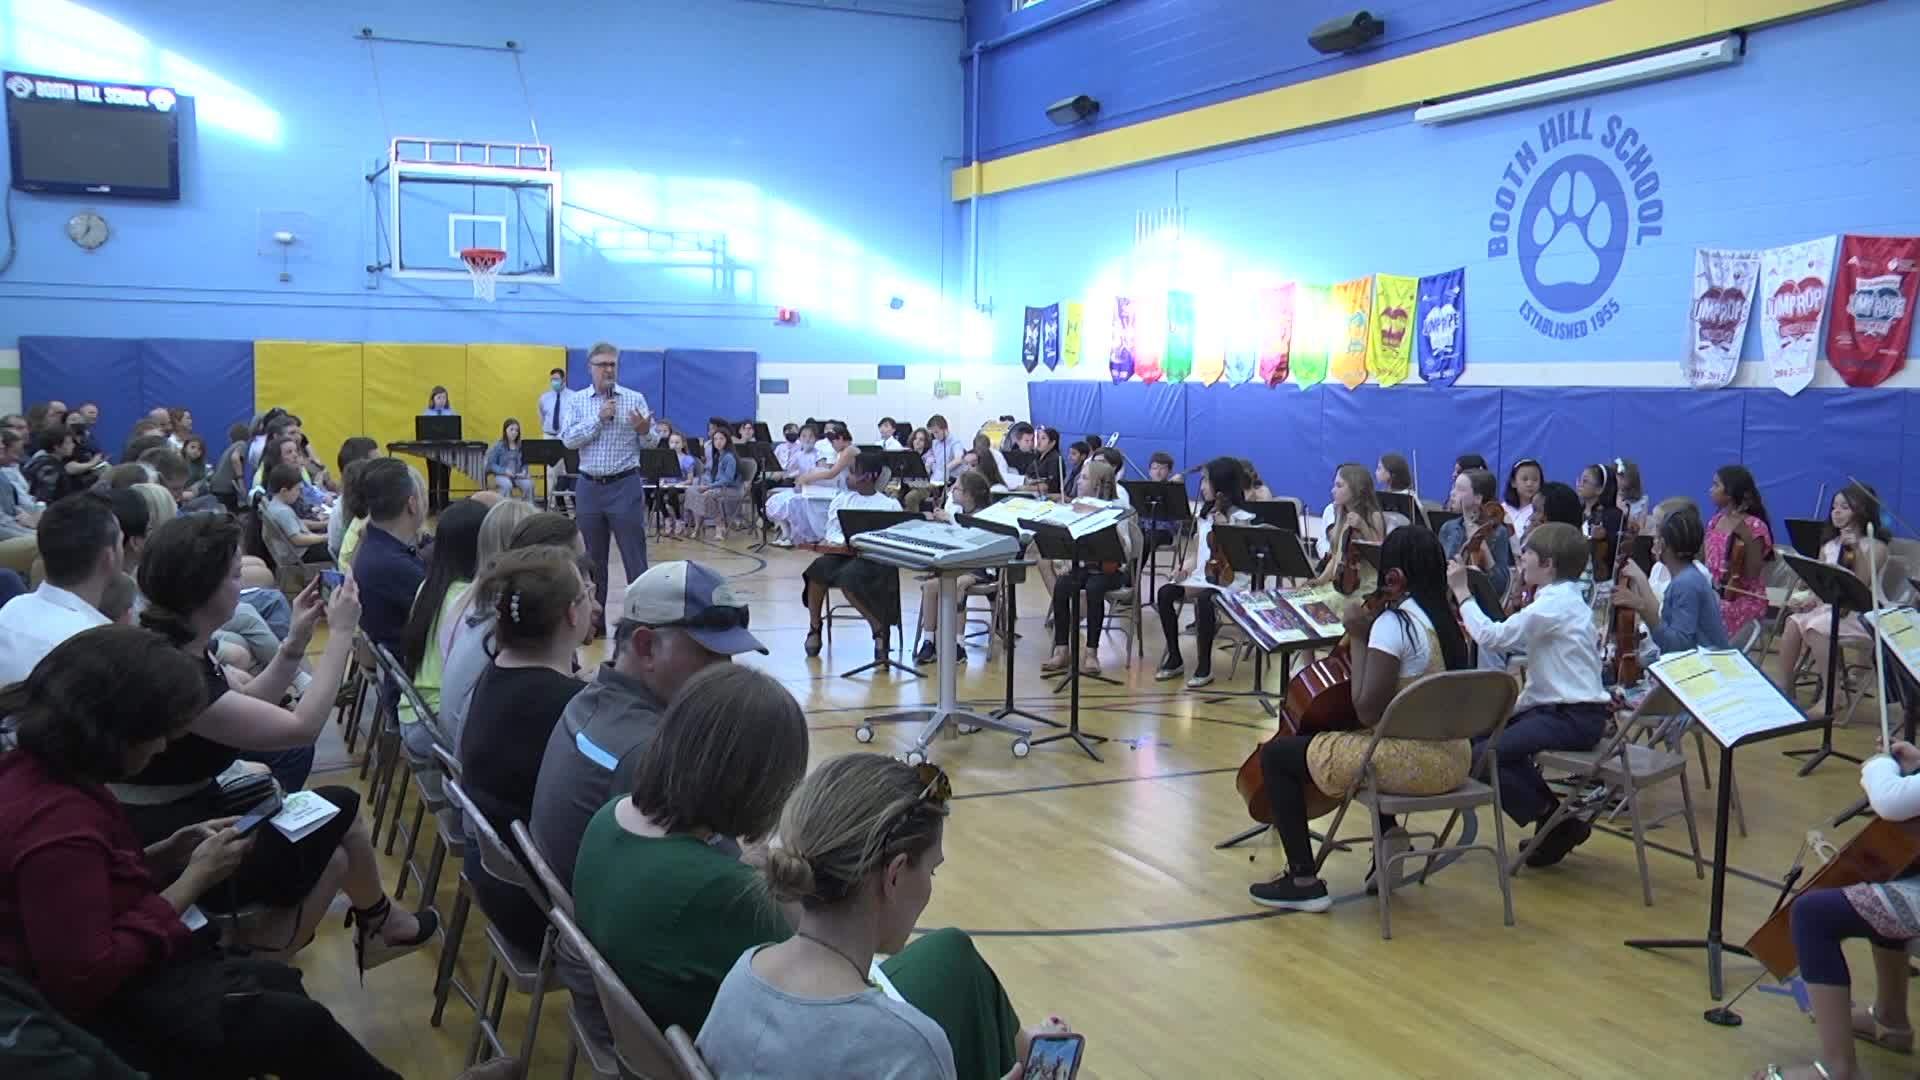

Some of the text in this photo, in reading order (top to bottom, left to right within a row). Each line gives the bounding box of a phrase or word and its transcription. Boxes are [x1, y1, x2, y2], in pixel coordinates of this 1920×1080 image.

[1487, 107, 1664, 258] BOOTH HILL SCHOOL
[1519, 297, 1620, 341] ESTABLISHED 1955
